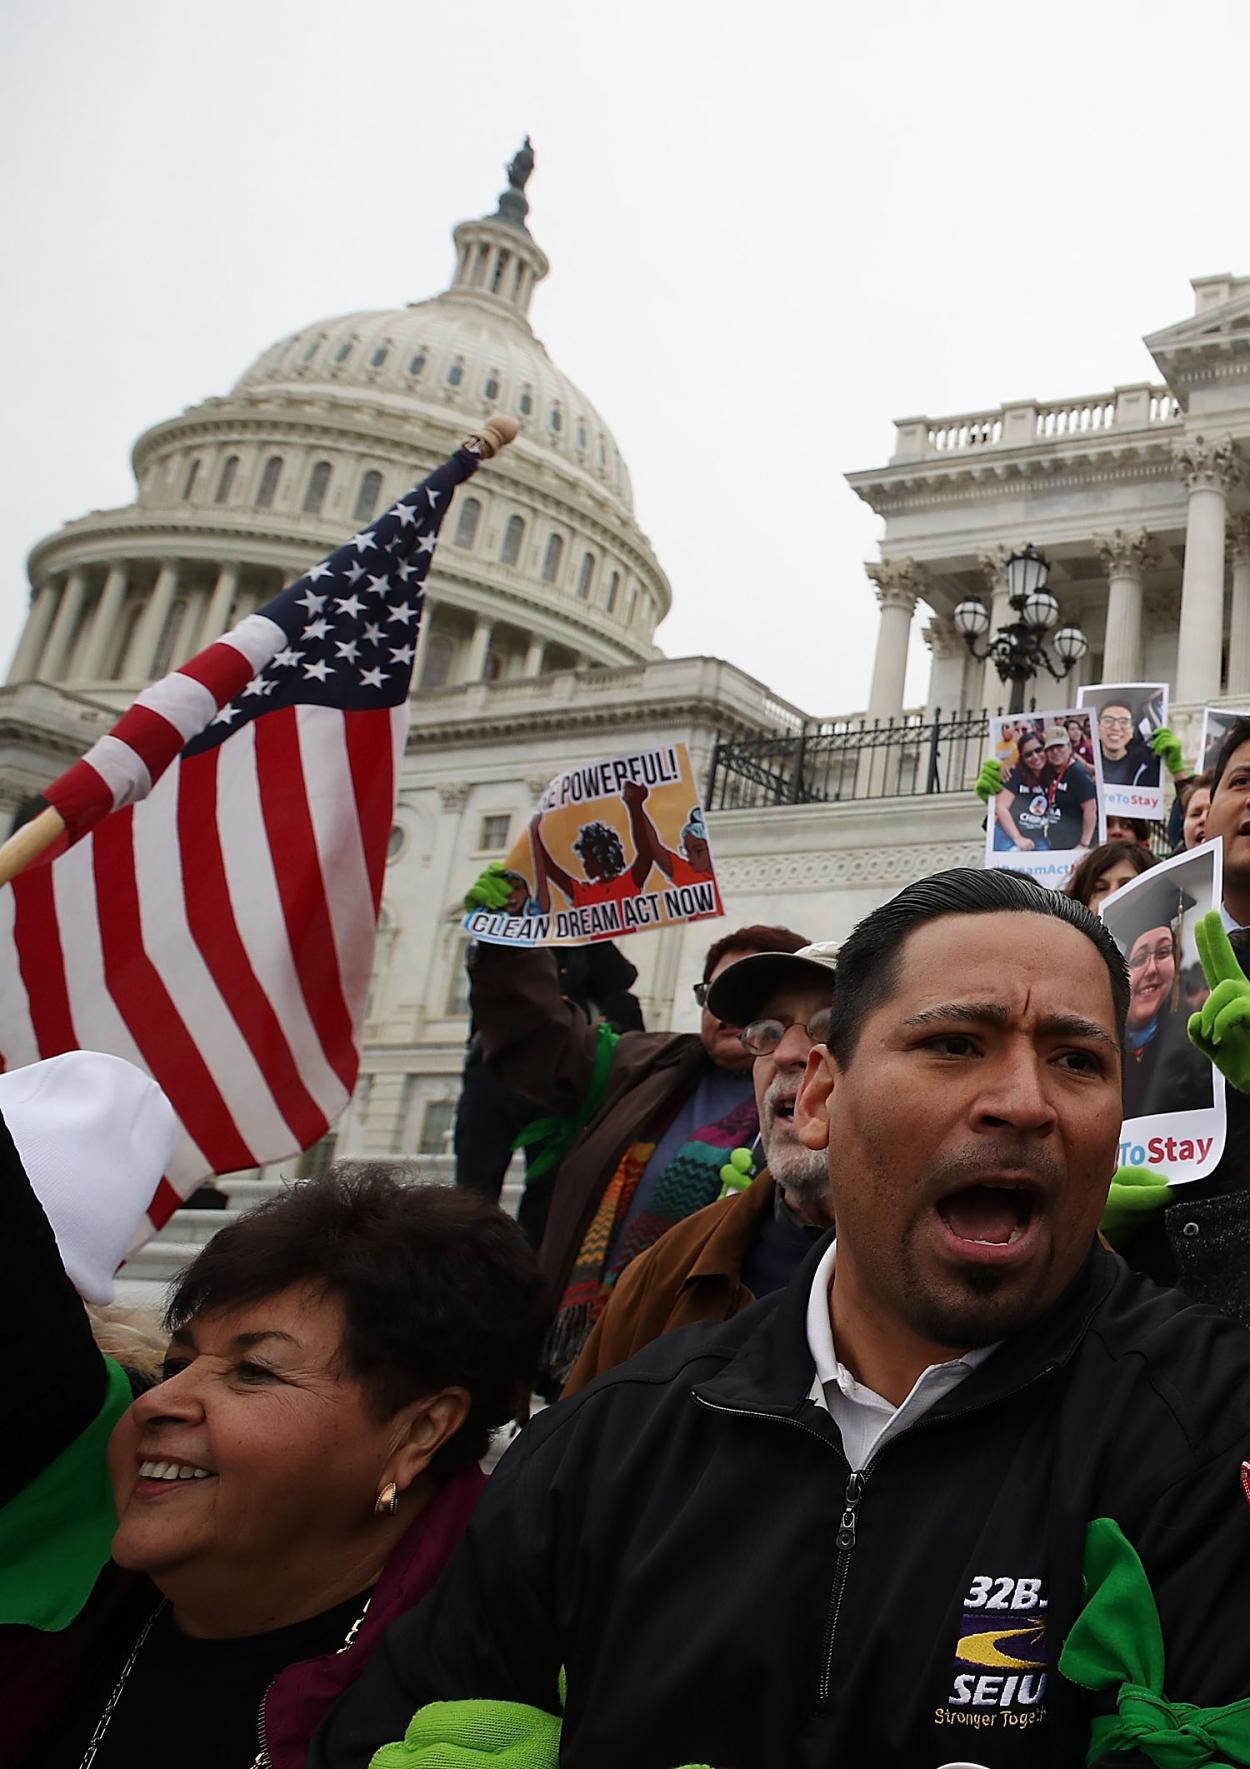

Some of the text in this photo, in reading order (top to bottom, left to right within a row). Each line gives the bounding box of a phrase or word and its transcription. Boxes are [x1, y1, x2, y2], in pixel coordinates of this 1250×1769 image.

[472, 883, 714, 939] CLEAN DREAM ACT NOW
[949, 1673, 1047, 1706] SEIU
[934, 1707, 997, 1729] Stronger
